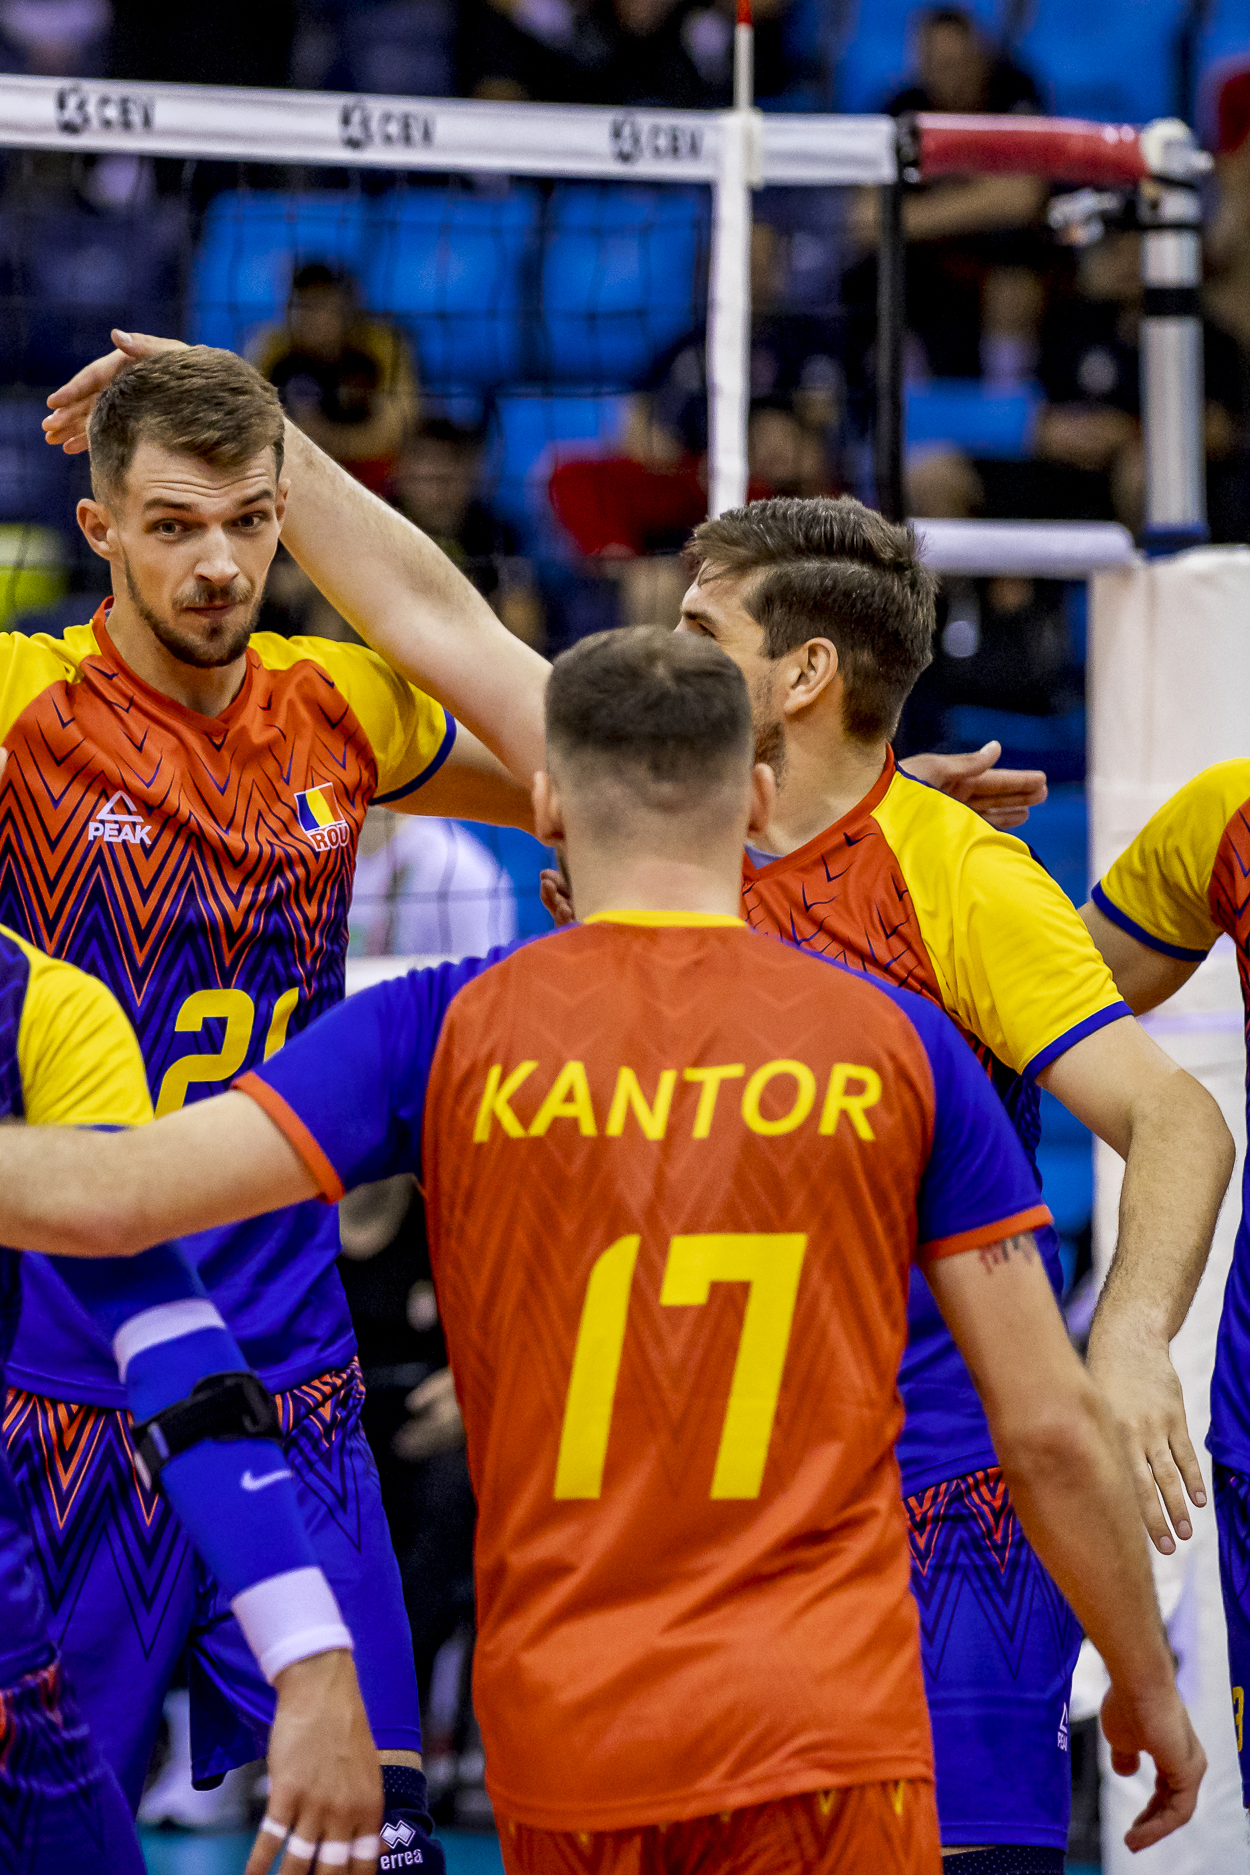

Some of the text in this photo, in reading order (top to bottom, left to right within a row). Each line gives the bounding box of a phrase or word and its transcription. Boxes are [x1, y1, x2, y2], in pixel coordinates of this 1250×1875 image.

[96, 94, 154, 131] CEV
[379, 110, 435, 148] CEV
[648, 124, 704, 160] CEV
[87, 821, 152, 844] PEAK
[308, 822, 350, 852] ROU
[473, 1059, 883, 1143] KANTOR
[553, 1232, 808, 1500] 17
